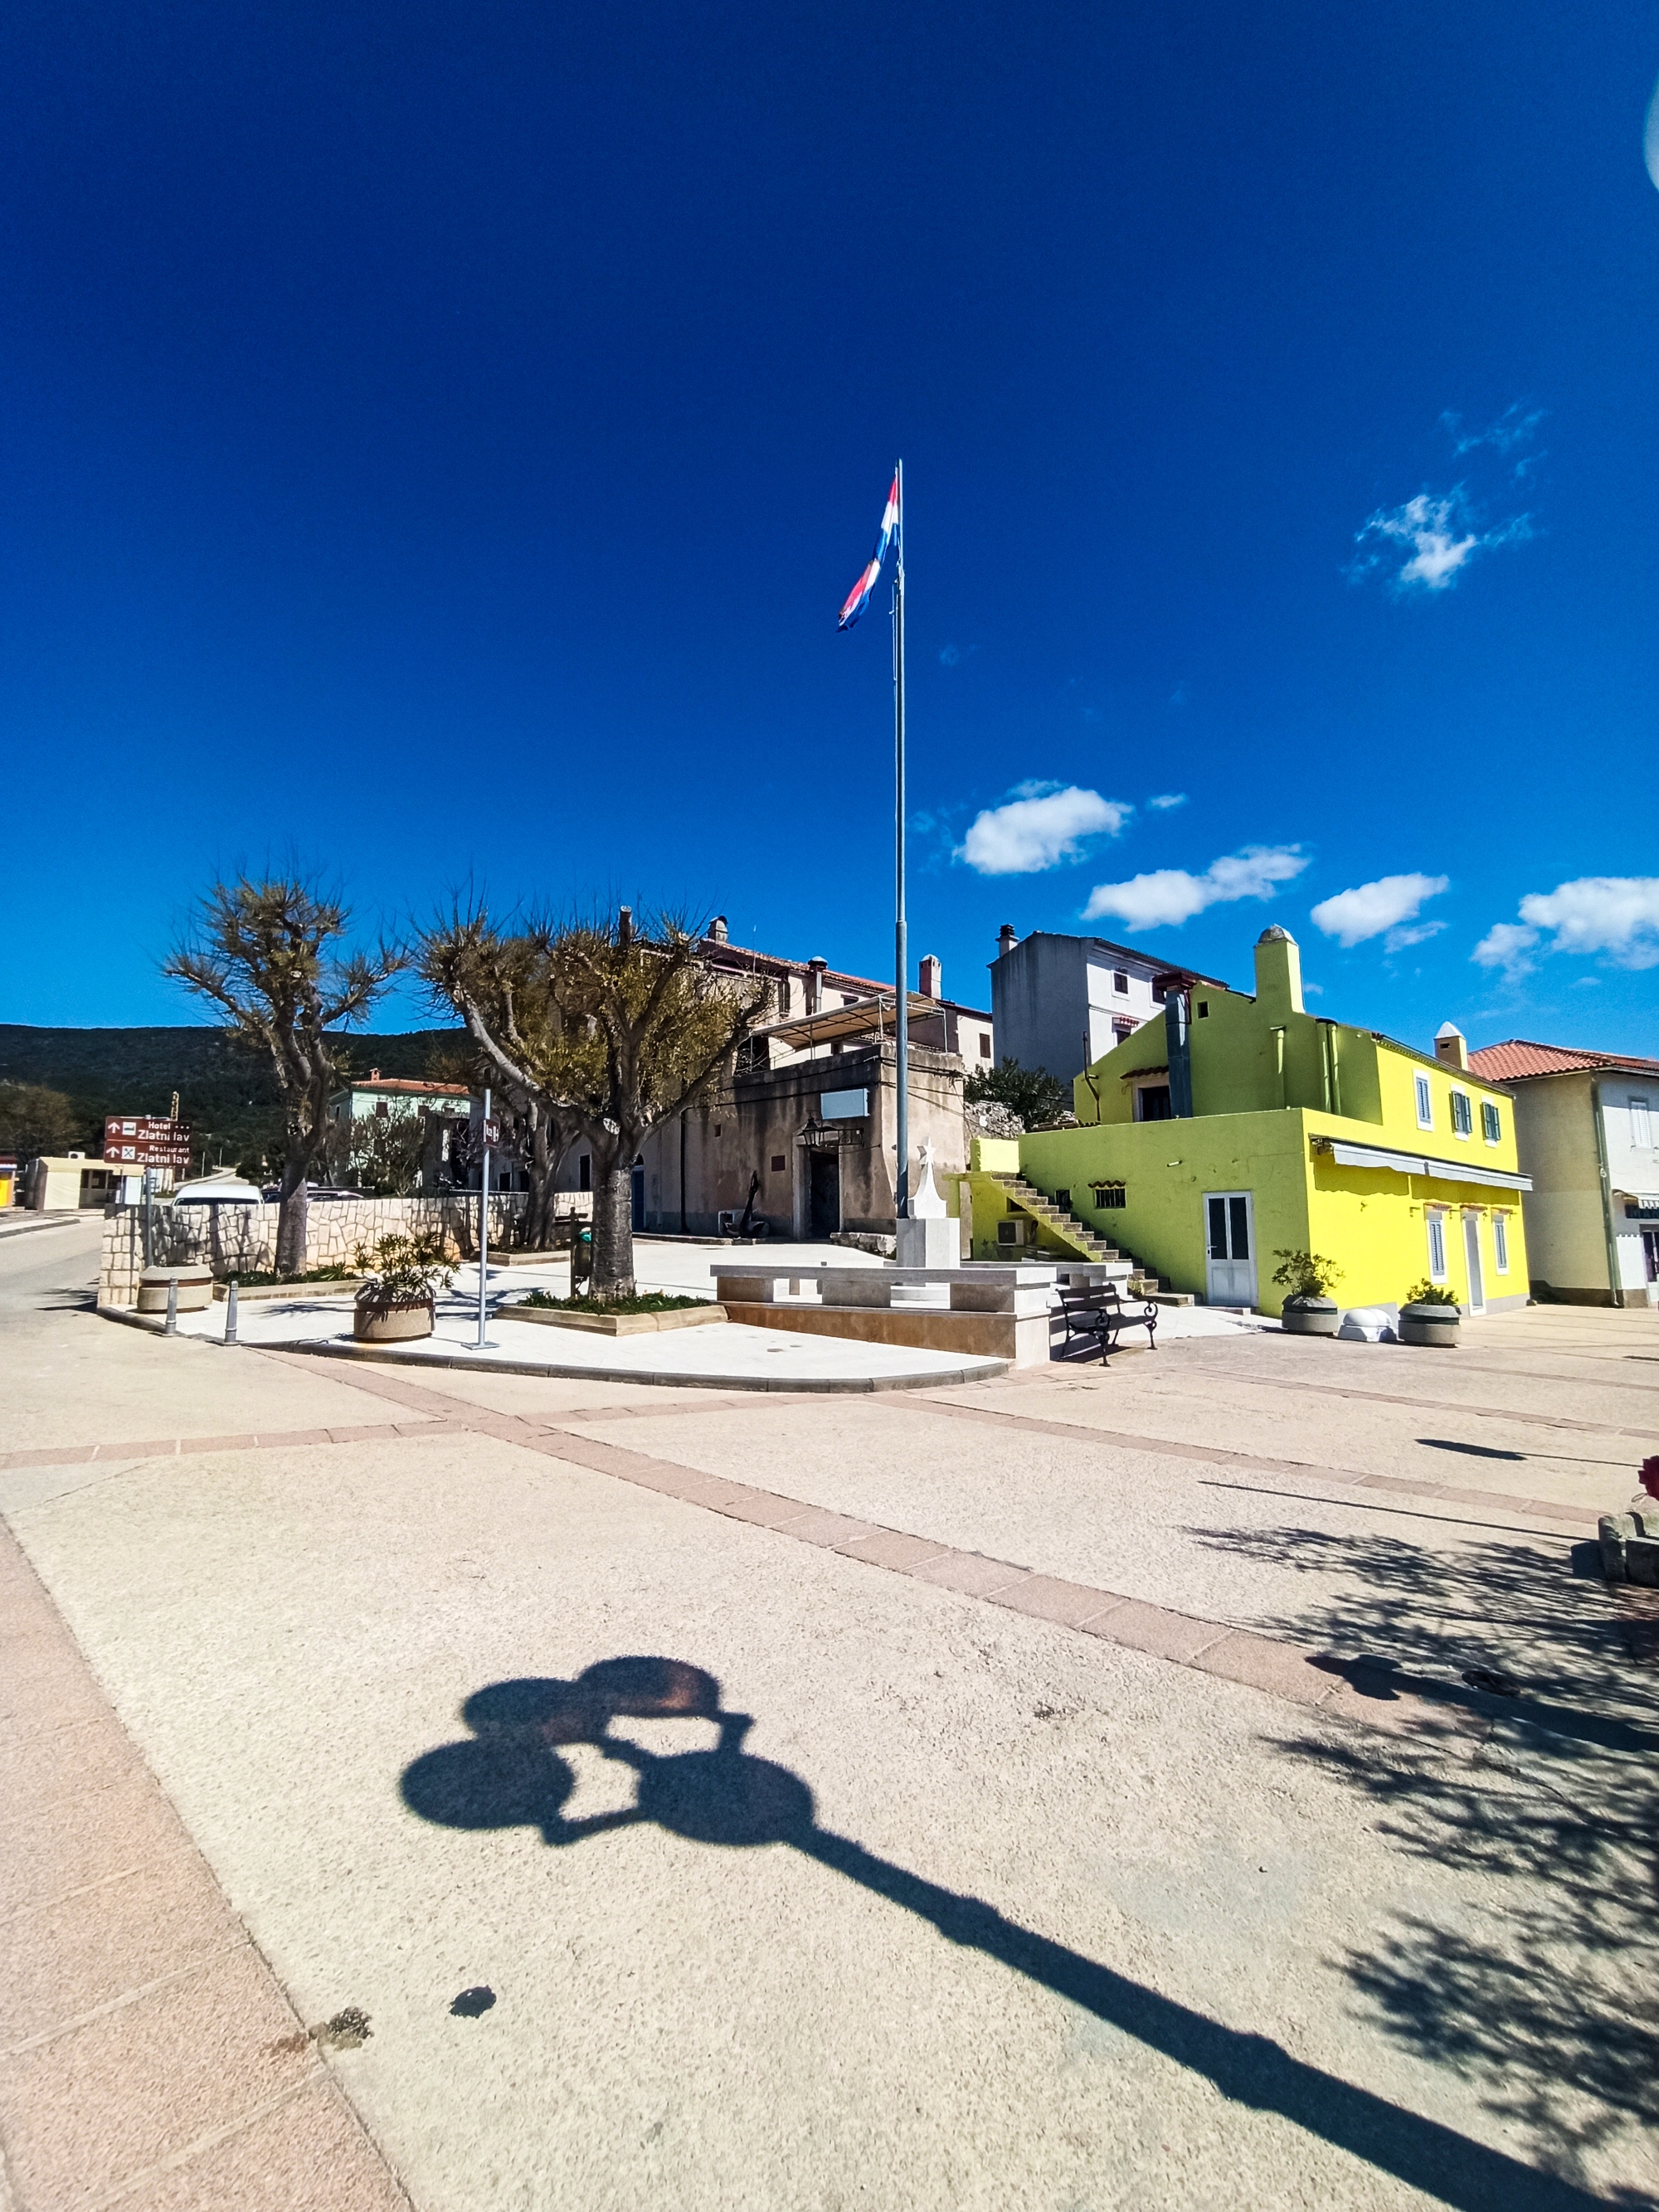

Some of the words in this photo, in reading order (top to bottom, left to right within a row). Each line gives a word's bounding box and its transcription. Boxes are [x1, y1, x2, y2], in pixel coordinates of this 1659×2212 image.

[148, 1121, 171, 1130] Hotel
[138, 1130, 170, 1141] Zlatni
[173, 1132, 190, 1141] lav
[137, 1153, 170, 1164] Zlatni
[173, 1155, 190, 1164] lav
